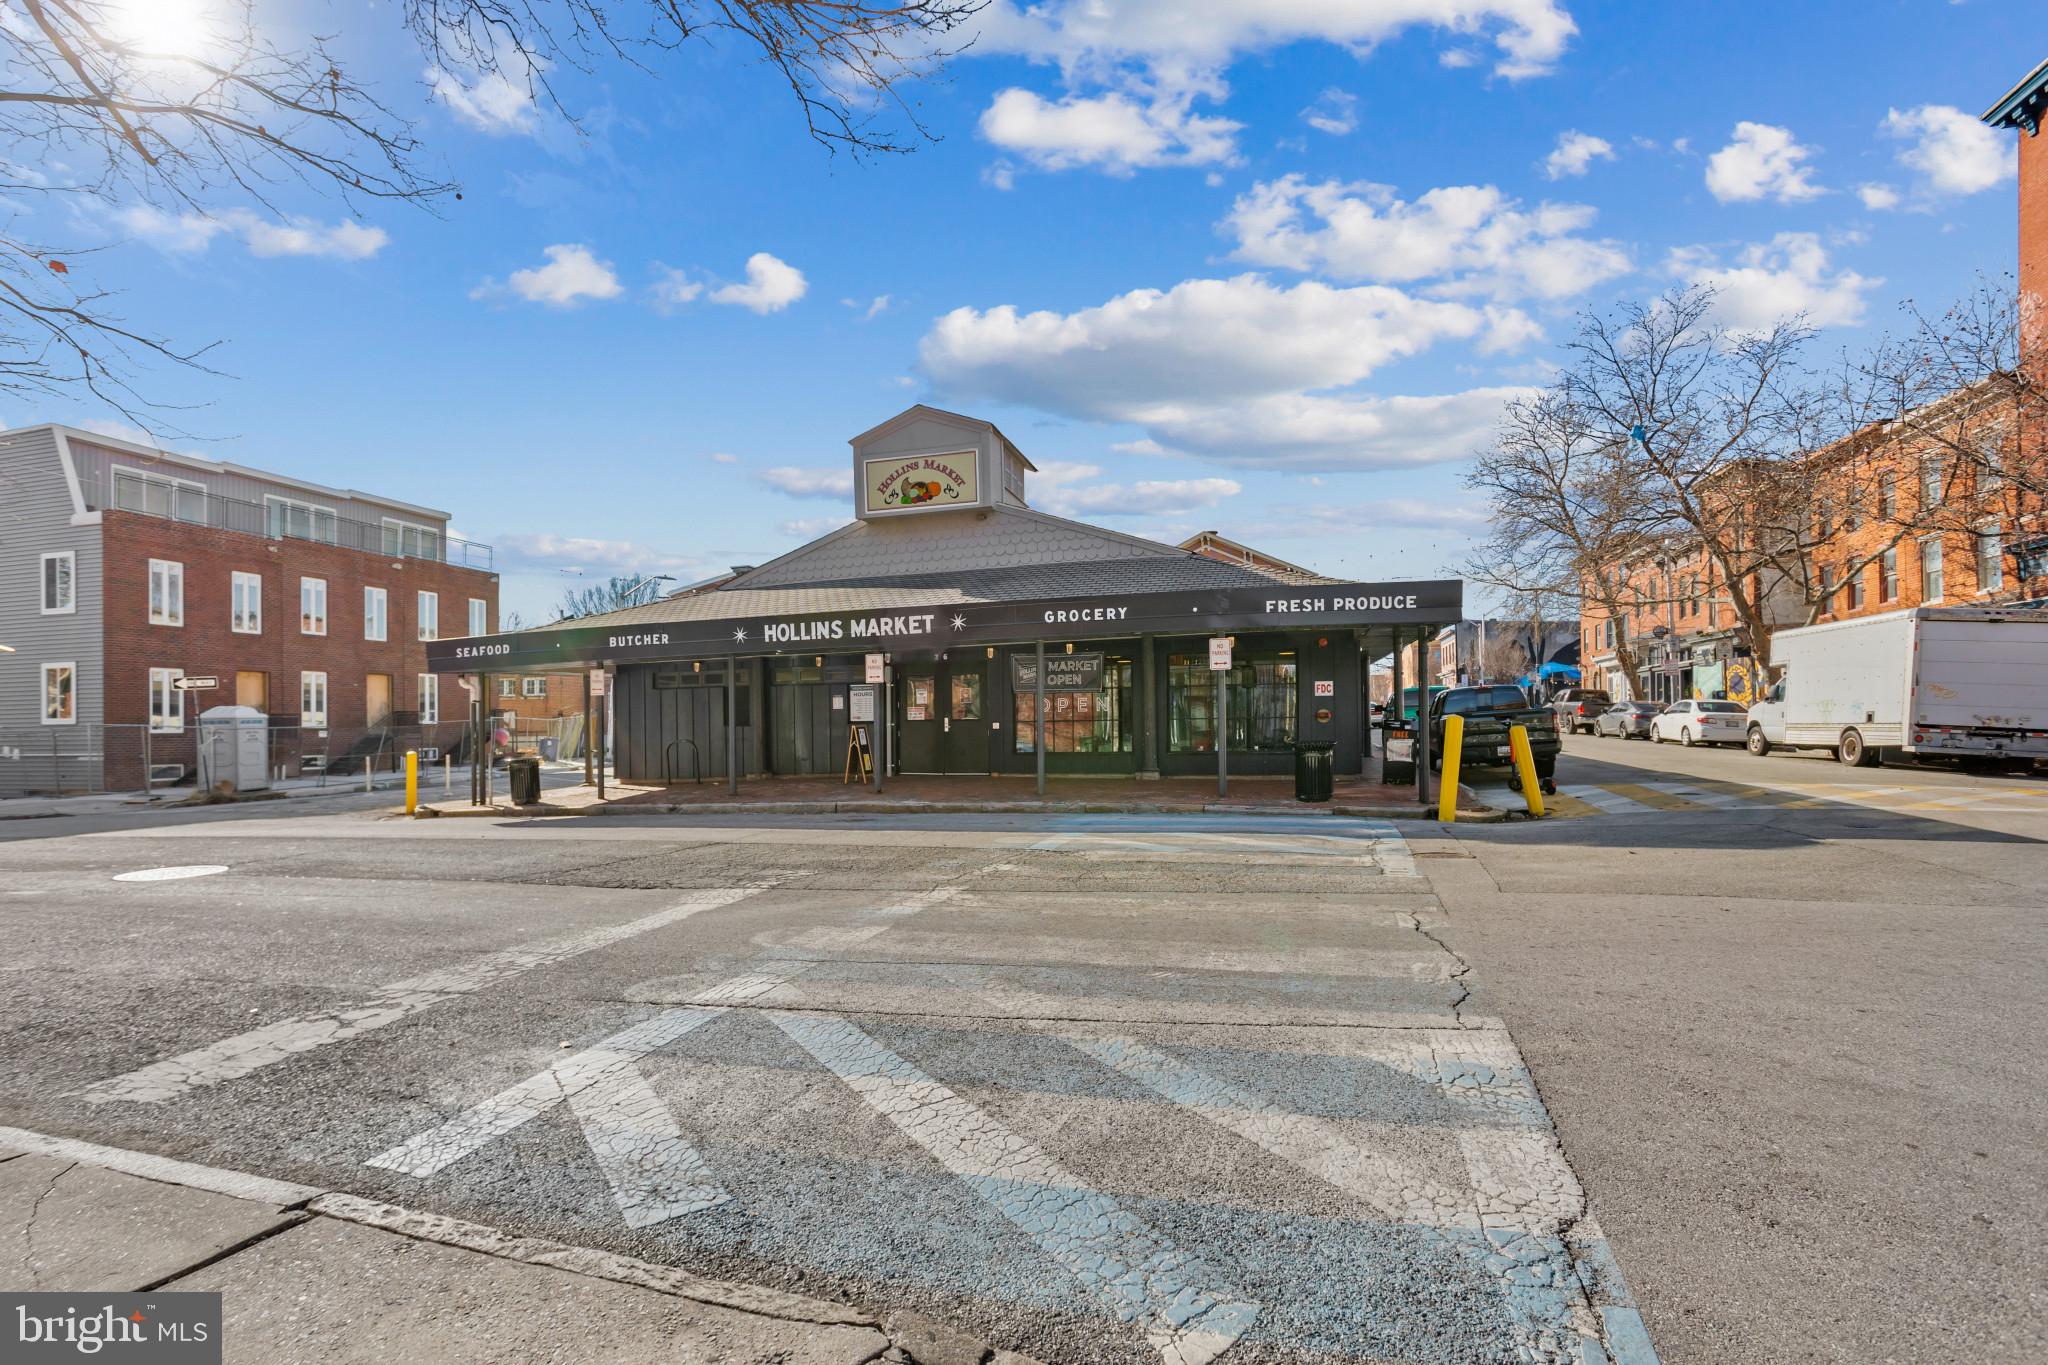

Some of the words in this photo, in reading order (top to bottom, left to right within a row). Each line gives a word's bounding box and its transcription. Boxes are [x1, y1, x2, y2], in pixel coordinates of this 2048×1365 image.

[877, 461, 919, 495] HOLLINS
[923, 459, 966, 487] MARKET
[1265, 598, 1325, 613] FRESH
[1333, 595, 1417, 611] PRODUCE
[1044, 607, 1128, 623] GROCERY
[764, 619, 843, 643] HOLLINS
[850, 614, 935, 638] MARKET
[608, 633, 670, 648] BUTCHER
[455, 644, 511, 658] SEAFOOD
[1047, 659, 1099, 672] MARKET
[1047, 673, 1082, 685] OPEN
[1316, 684, 1332, 694] FDC
